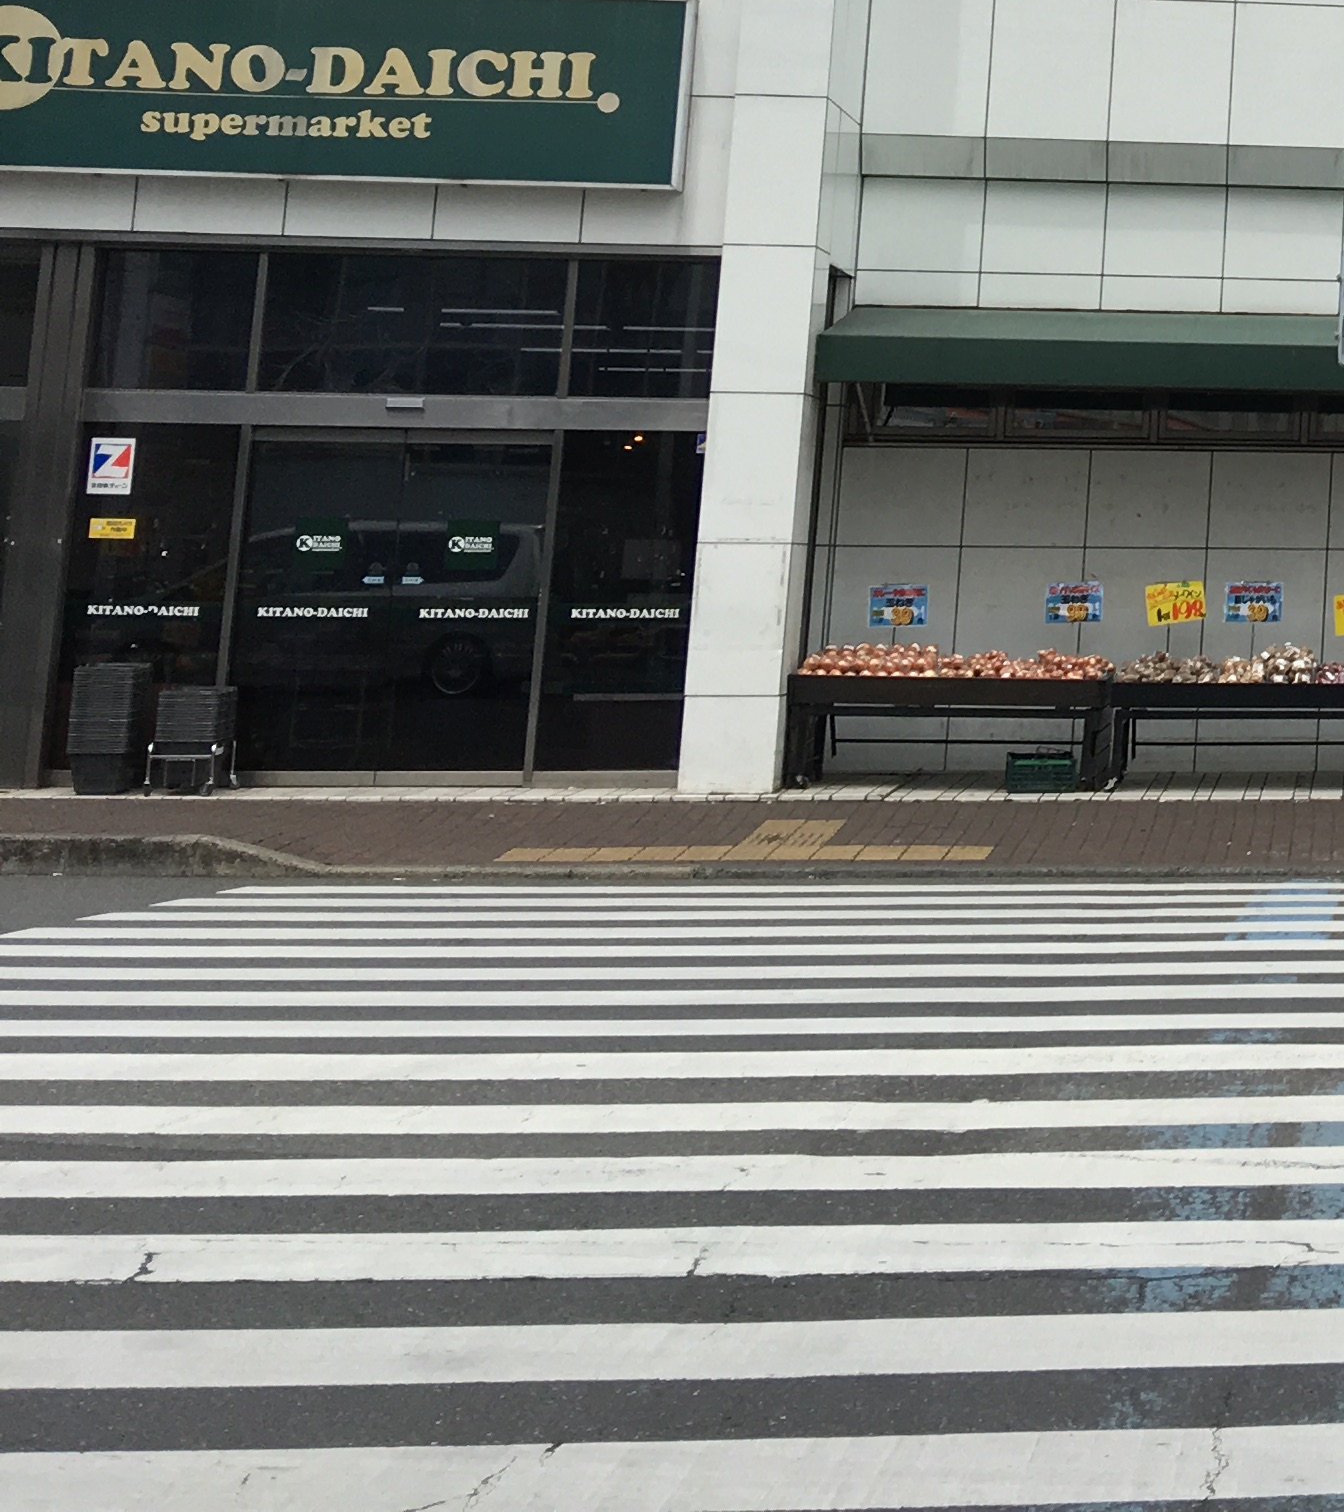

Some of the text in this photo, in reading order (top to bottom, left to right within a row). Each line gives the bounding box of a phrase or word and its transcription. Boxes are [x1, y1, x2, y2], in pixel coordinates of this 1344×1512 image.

[139, 107, 432, 141] supermarket
[257, 607, 368, 618] KITANO-DAICHI
[419, 608, 529, 619] KITANO-DAICHI
[571, 608, 680, 619] KITANO-DAICHI
